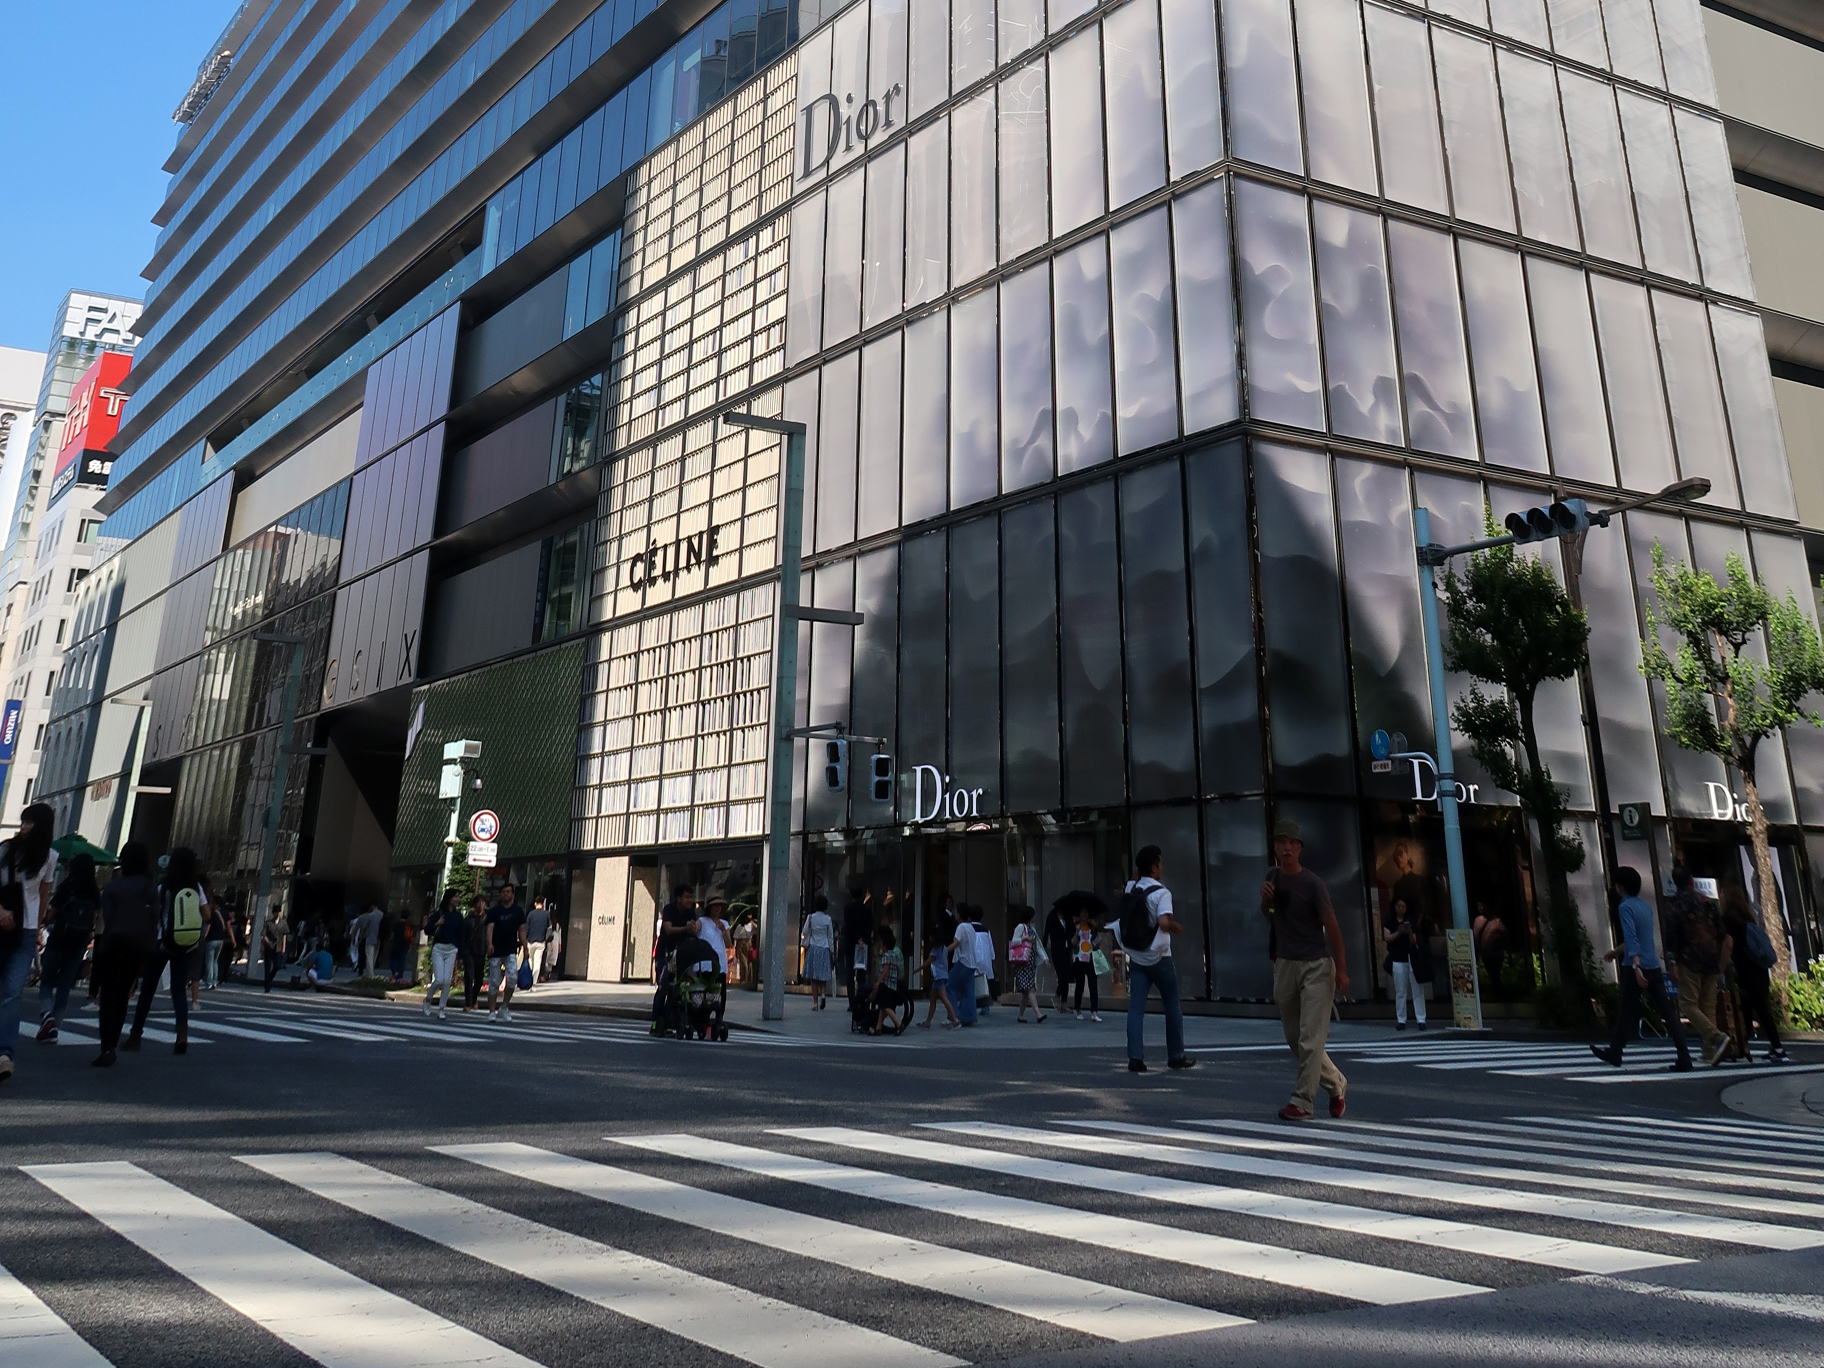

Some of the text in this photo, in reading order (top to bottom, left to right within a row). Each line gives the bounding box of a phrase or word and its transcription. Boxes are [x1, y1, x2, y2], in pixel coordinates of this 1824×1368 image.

[796, 83, 900, 182] Dior
[79, 299, 139, 342] FA
[630, 523, 719, 593] CÉLINE
[4, 710, 18, 744] MIZUHO
[911, 765, 983, 821] Dior
[1409, 758, 1479, 804] Dor
[1704, 781, 1764, 822] Dio
